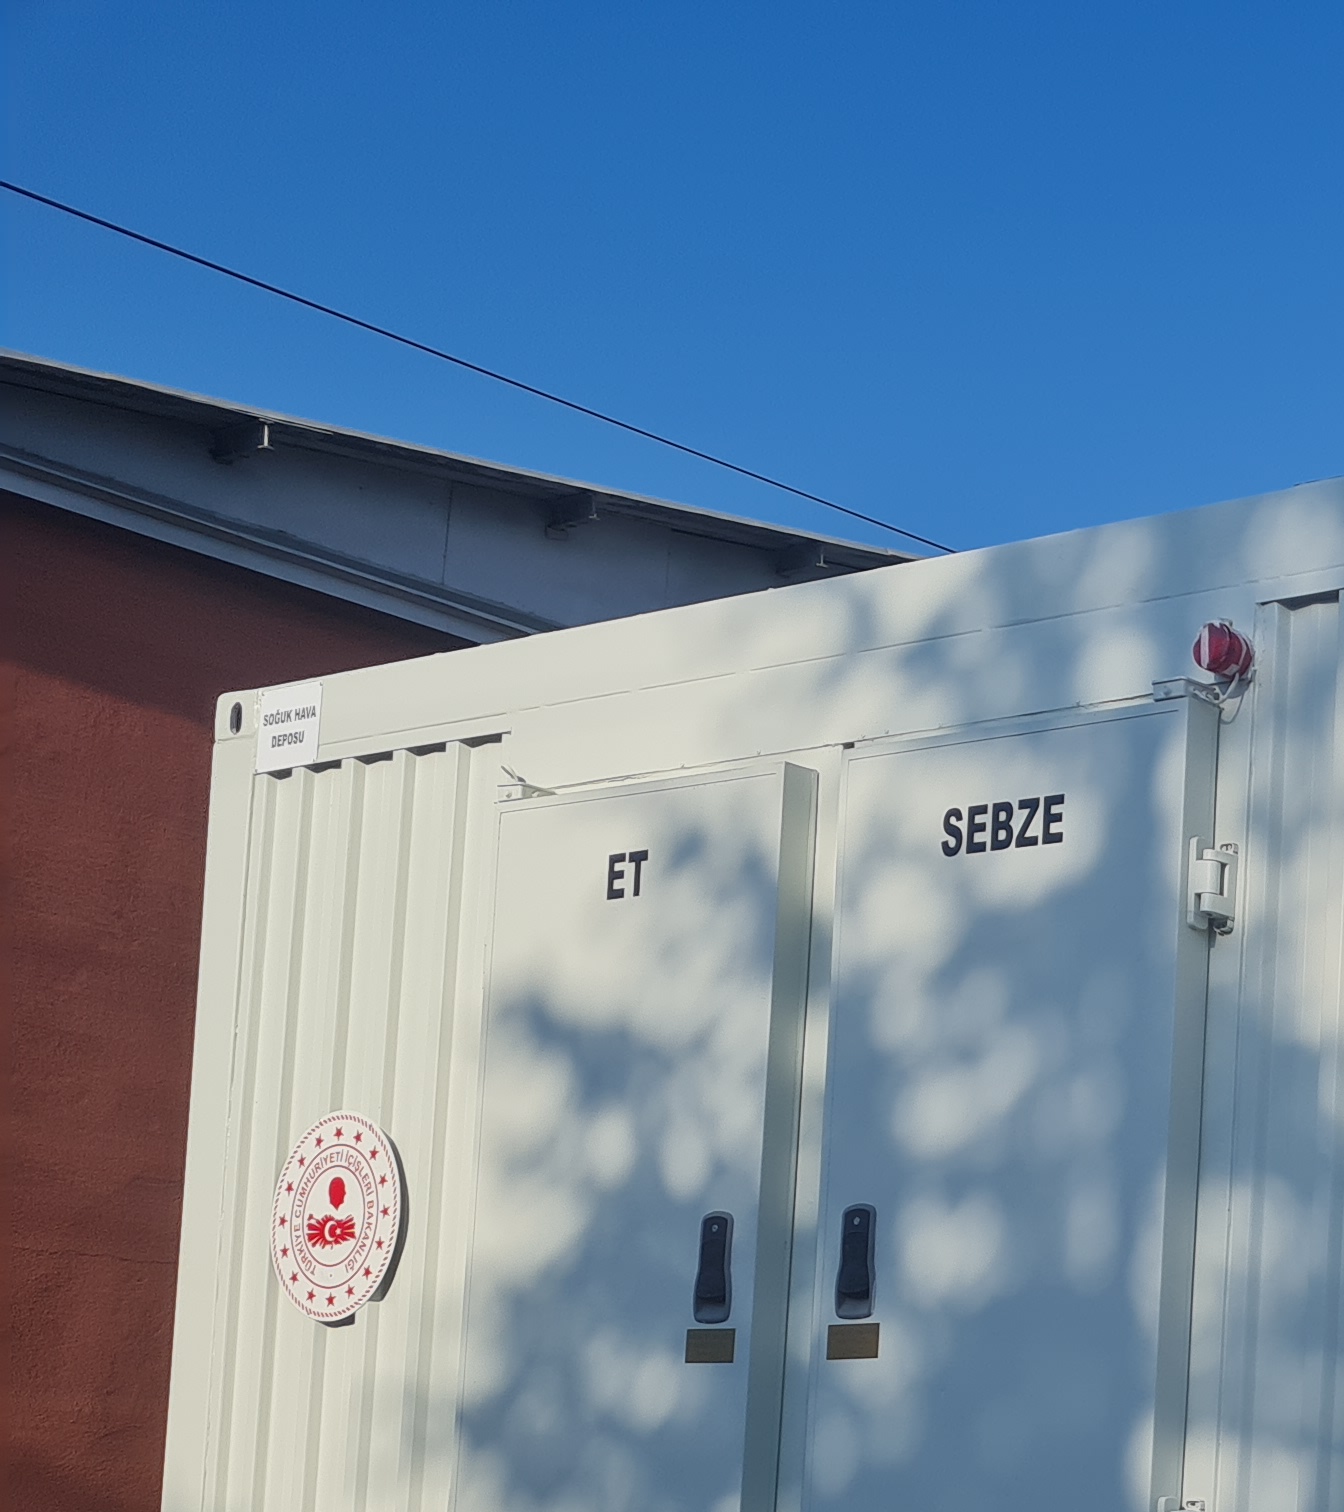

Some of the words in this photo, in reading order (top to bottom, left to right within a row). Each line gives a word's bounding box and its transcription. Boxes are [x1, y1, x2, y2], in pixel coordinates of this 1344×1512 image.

[263, 708, 292, 727] SOĞUK
[294, 705, 317, 721] HAVA
[271, 731, 305, 748] DEPOSU
[940, 794, 1065, 857] SEBZE
[606, 849, 649, 900] ET
[294, 1149, 344, 1218] CUMHURİYETİ
